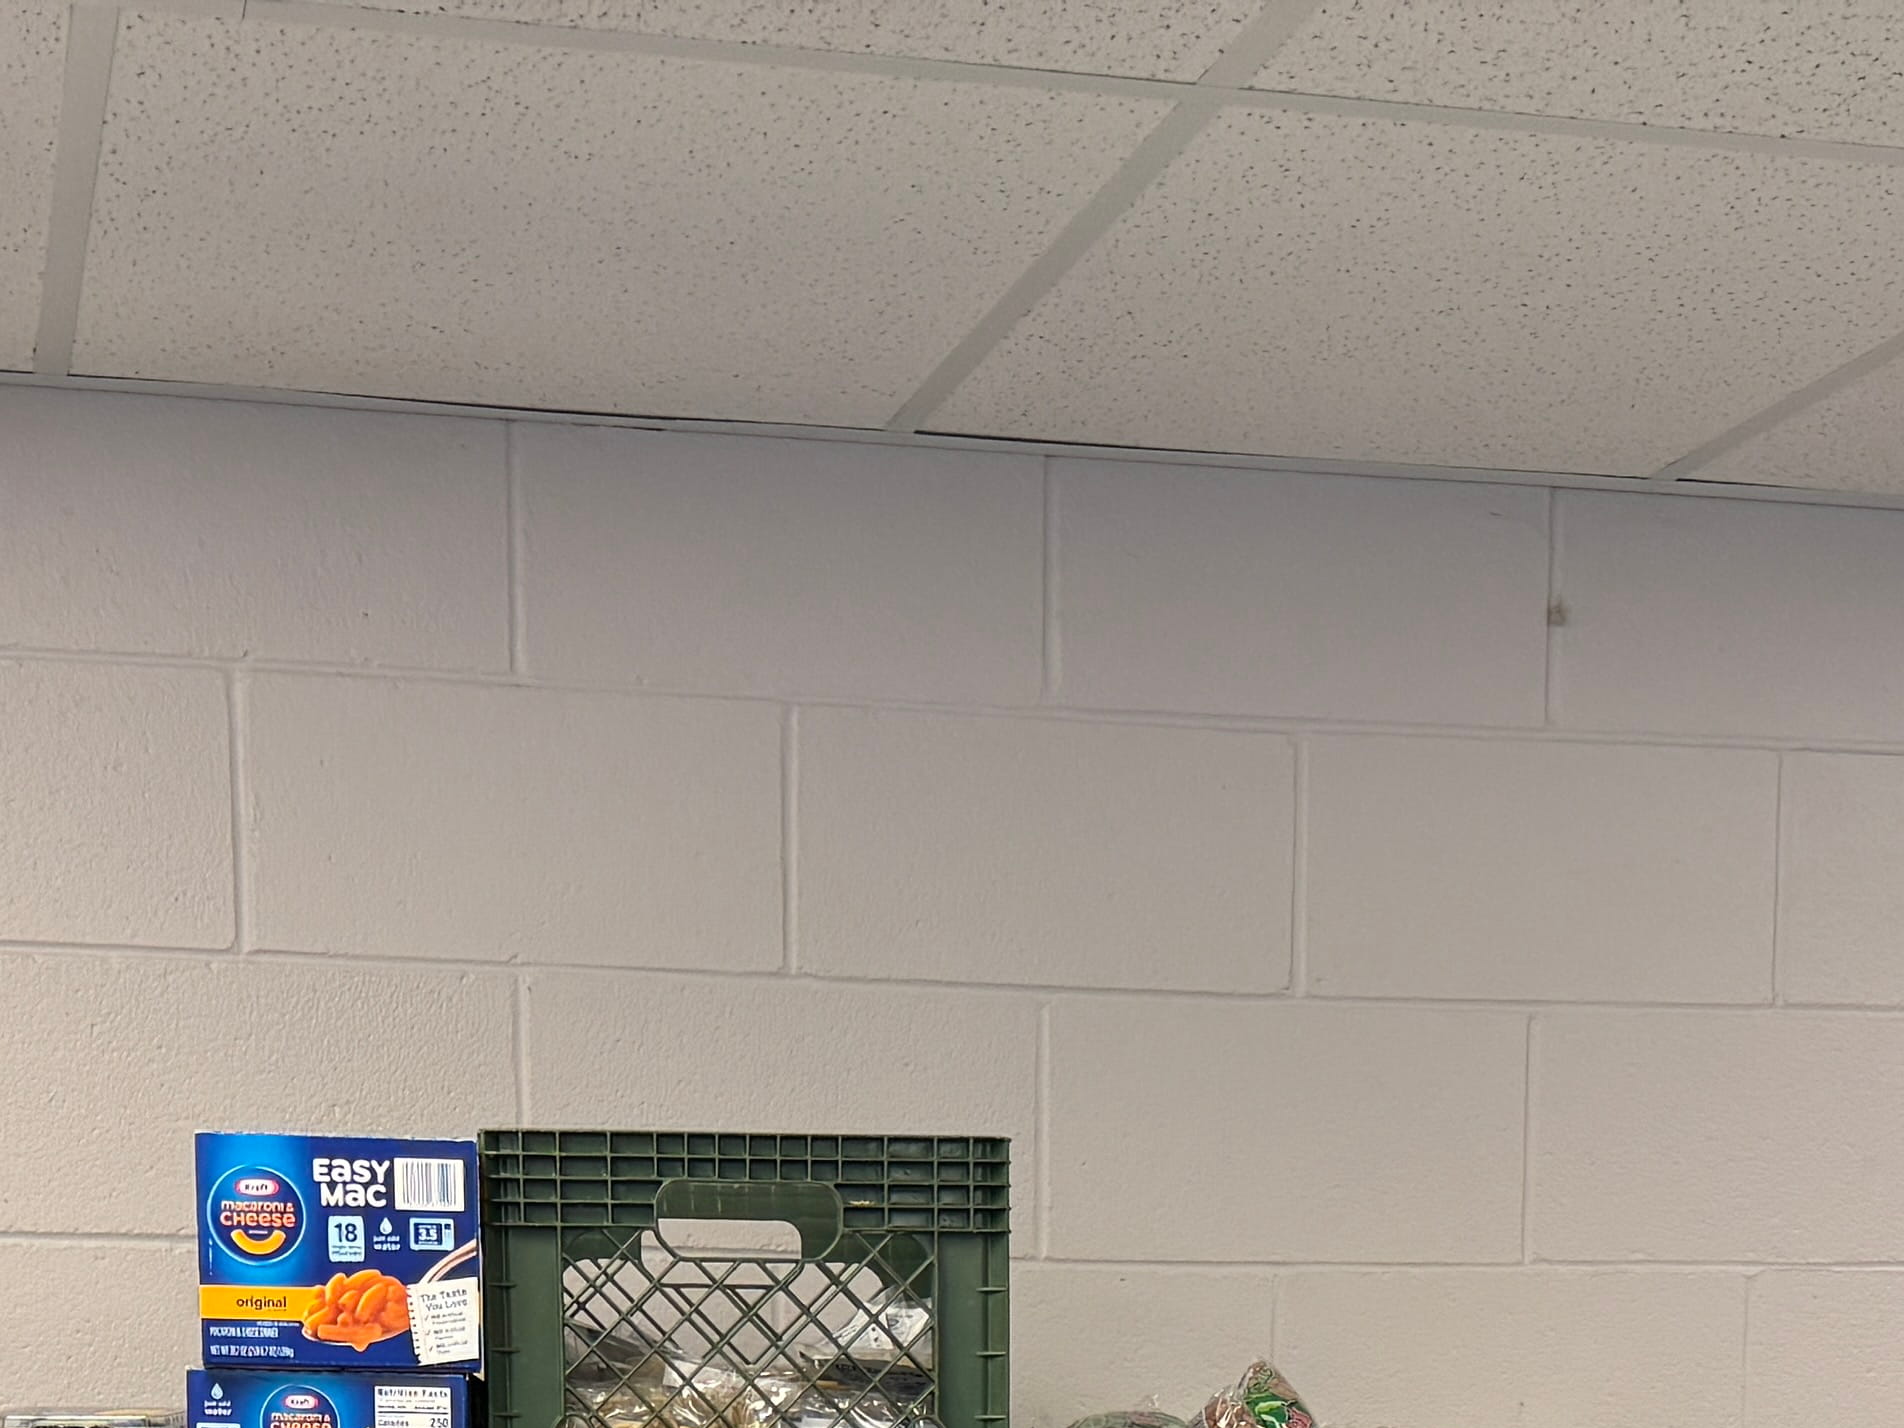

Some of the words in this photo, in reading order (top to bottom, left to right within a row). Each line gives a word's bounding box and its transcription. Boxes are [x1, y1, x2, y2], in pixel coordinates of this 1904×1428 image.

[334, 1223, 357, 1241] 18
[418, 1227, 437, 1240] 3.5
[374, 1241, 400, 1251] water
[236, 1296, 287, 1310] original
